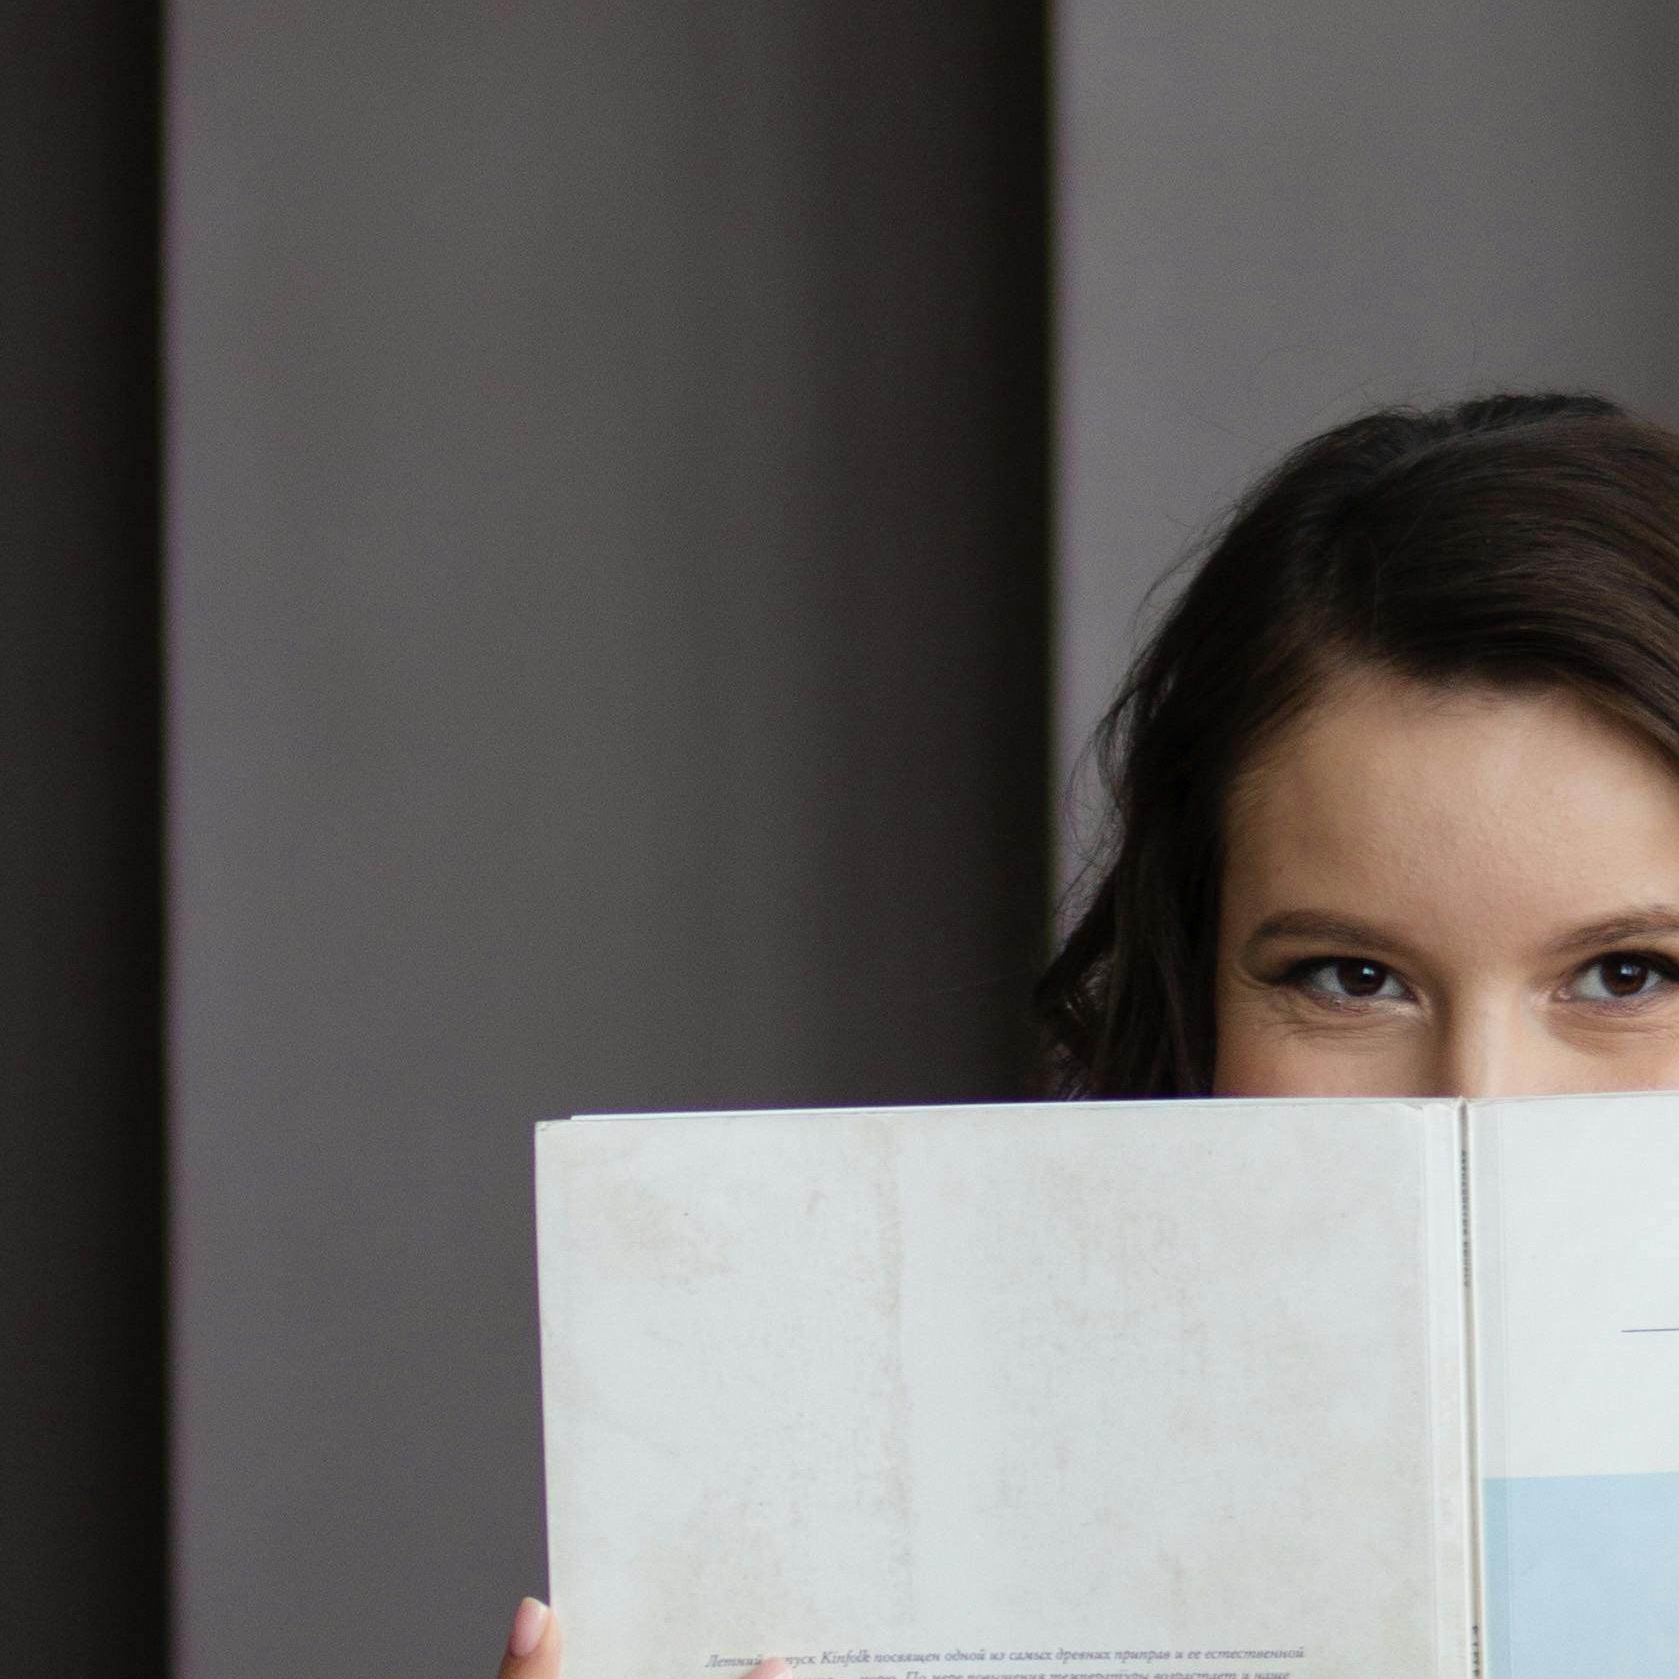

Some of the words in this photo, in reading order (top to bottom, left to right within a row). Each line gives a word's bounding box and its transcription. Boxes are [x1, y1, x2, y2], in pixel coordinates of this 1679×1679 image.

[705, 1654, 763, 1668] Летний
[820, 1649, 870, 1667] Kinfolk
[875, 1653, 940, 1663] посвящен
[945, 1649, 986, 1661] одной
[989, 1652, 1005, 1661] из
[1009, 1652, 1052, 1661] самых
[1055, 1648, 1110, 1664] древних
[1114, 1650, 1170, 1664] приправ
[1204, 1647, 1304, 1660] естественной
